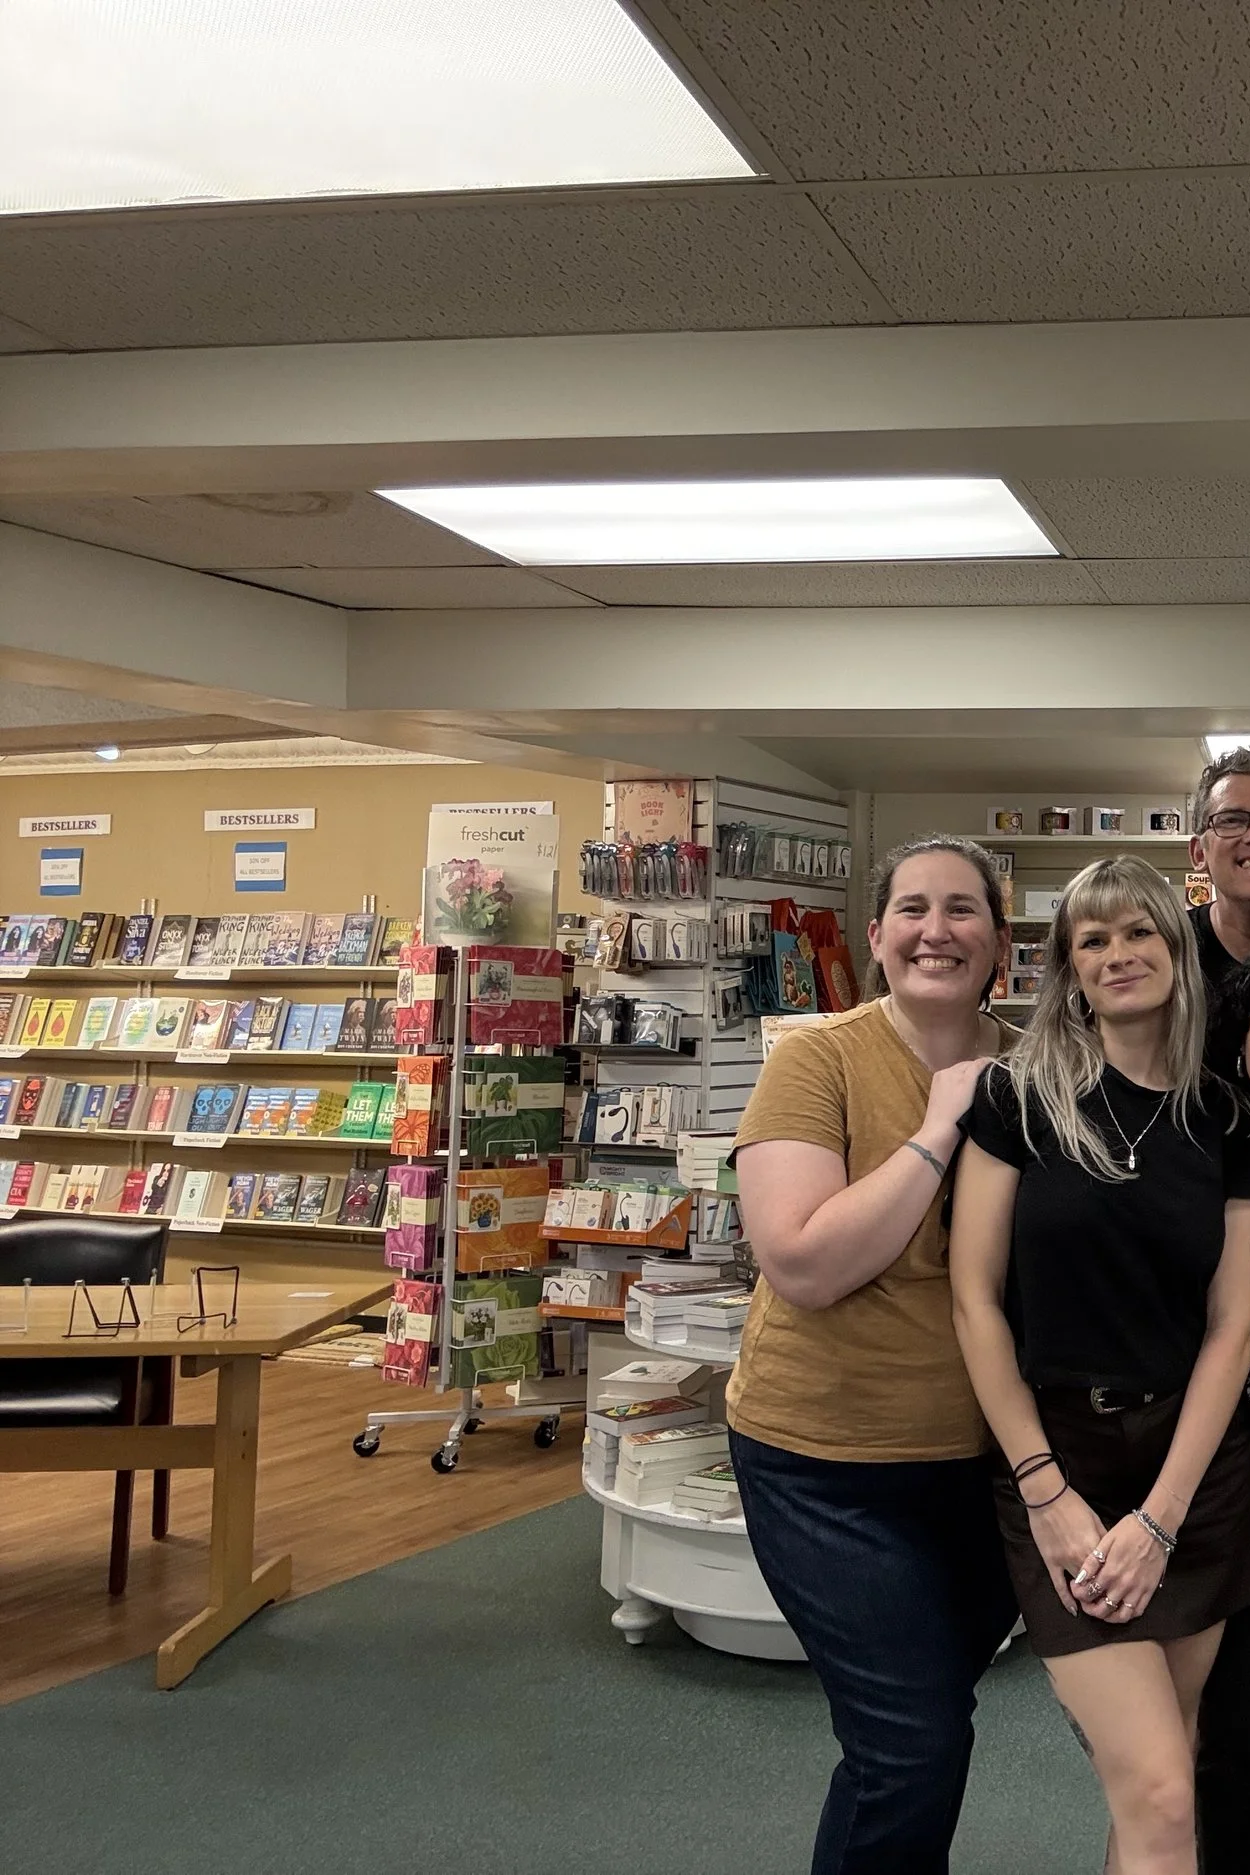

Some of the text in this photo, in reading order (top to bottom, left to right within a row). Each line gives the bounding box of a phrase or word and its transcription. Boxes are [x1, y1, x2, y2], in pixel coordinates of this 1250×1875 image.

[220, 814, 299, 825] BESTSELLERS
[31, 820, 97, 832] BESTSELLERS
[461, 825, 525, 841] freshcut
[1187, 875, 1210, 884] Soup
[219, 922, 245, 933] KING
[249, 922, 273, 932] KING
[162, 930, 182, 940] ONYX
[353, 1100, 372, 1110] LET
[346, 1111, 374, 1121] THEM
